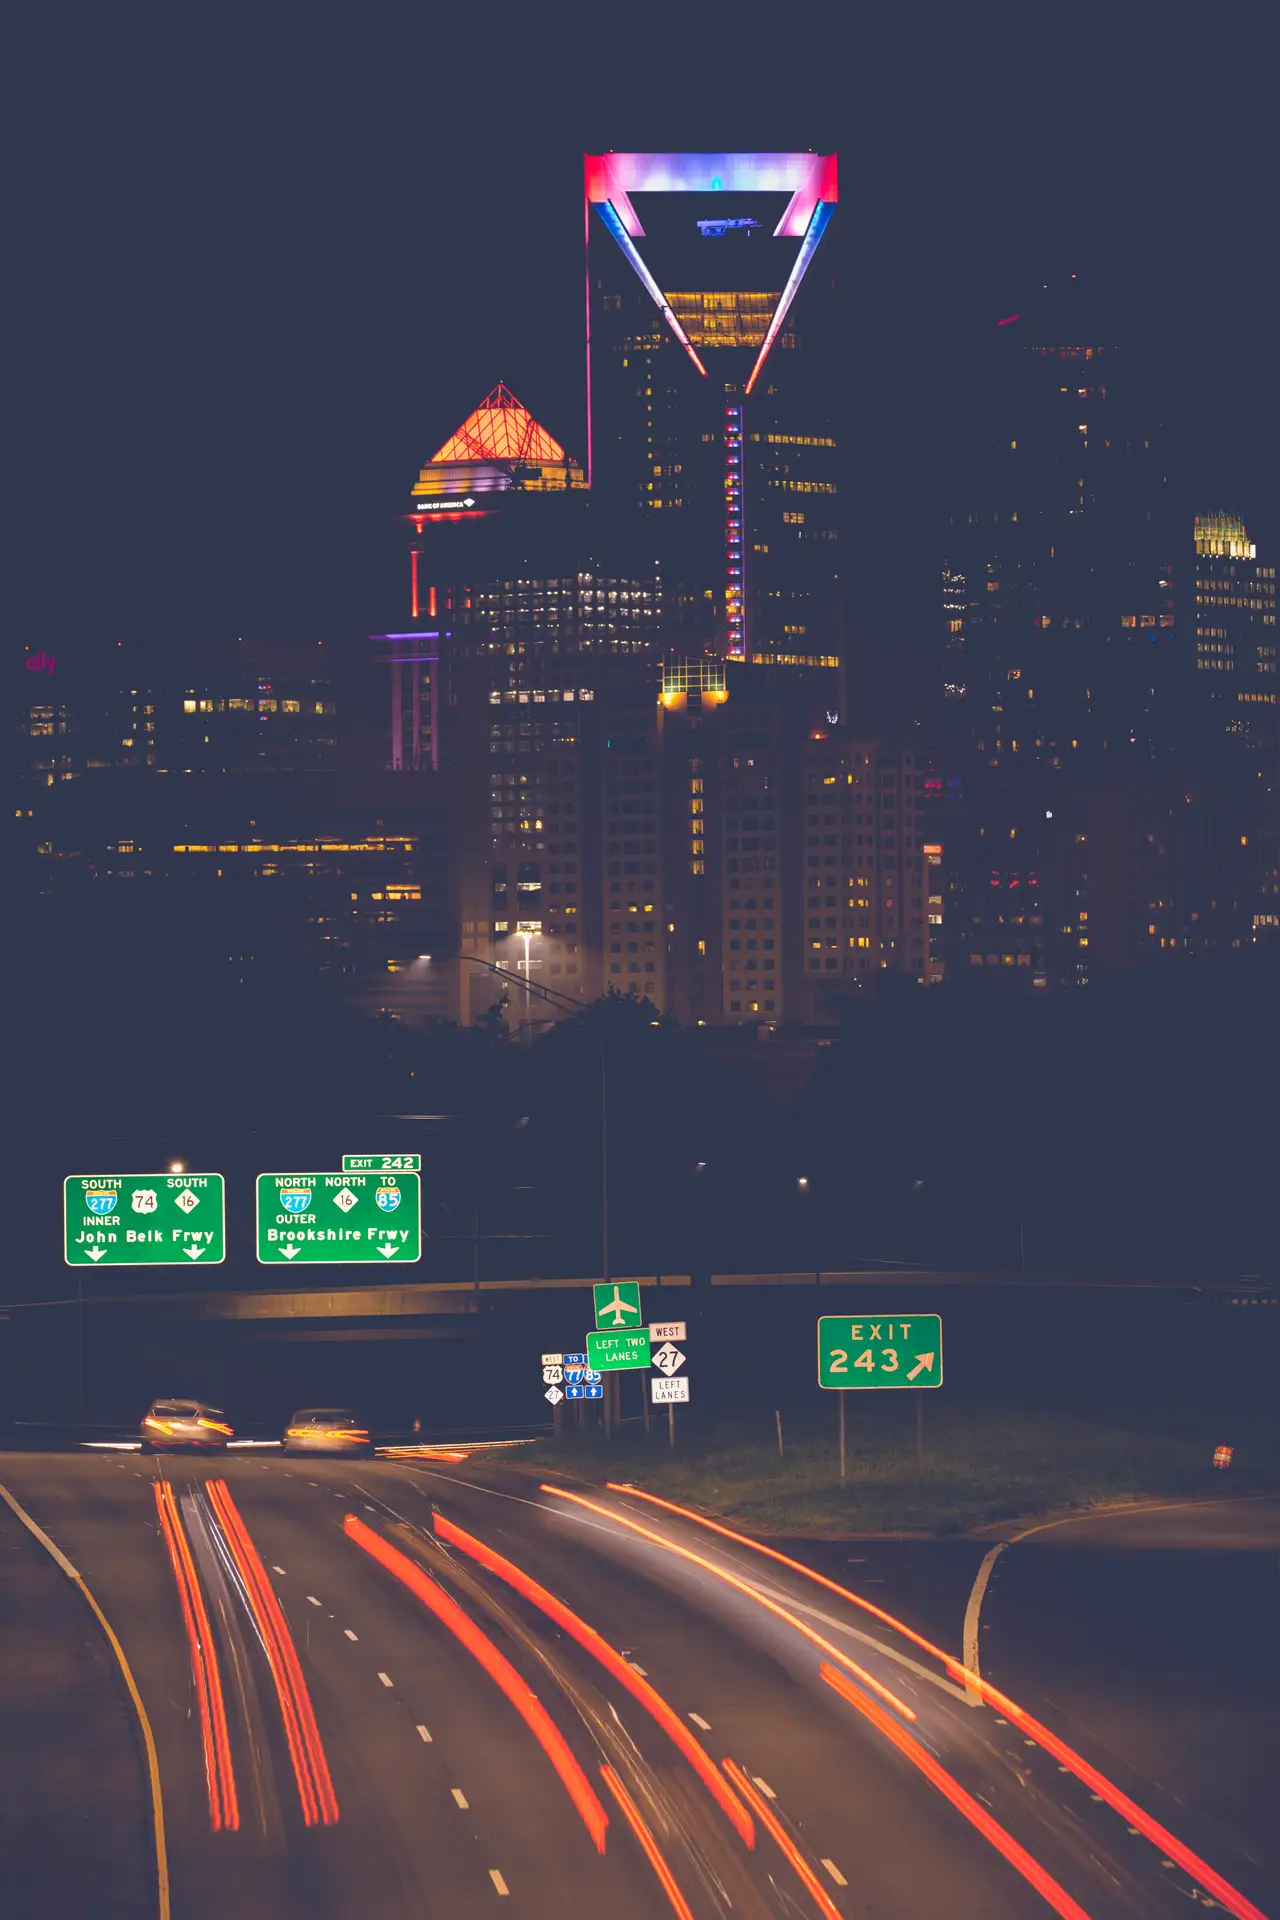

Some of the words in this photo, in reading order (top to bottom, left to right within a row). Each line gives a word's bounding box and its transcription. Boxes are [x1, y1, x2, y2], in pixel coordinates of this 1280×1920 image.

[25, 651, 57, 675] ally
[350, 1159, 373, 1168] EXIT
[381, 1157, 414, 1169] 242
[81, 1179, 122, 1189] SOUTH
[167, 1178, 208, 1188] SOUTH
[275, 1177, 316, 1187] NORTH
[325, 1177, 366, 1187] NORTH
[380, 1176, 396, 1186] TO
[90, 1198, 113, 1210] 277
[135, 1196, 154, 1208] 74
[182, 1195, 195, 1207] 16
[285, 1196, 308, 1208] 277
[340, 1194, 353, 1206] 16
[378, 1193, 399, 1207] 85
[83, 1216, 121, 1226] INNER
[276, 1214, 316, 1224] OUTER
[75, 1231, 117, 1243] John
[126, 1230, 163, 1242] Belk
[172, 1229, 214, 1244] Frwy
[267, 1228, 362, 1241] Brookshire
[367, 1227, 409, 1243] Frwy
[655, 1326, 680, 1337] WEST
[851, 1323, 912, 1341] EXIT
[595, 1339, 619, 1349] LEFT
[626, 1337, 646, 1347] TWO
[605, 1351, 638, 1362] LANES
[658, 1351, 679, 1368] 27
[829, 1348, 899, 1373] 243
[545, 1369, 560, 1380] 74
[566, 1370, 582, 1381] 77
[585, 1370, 601, 1381] 85
[659, 1380, 681, 1390] LEFT
[548, 1390, 559, 1400] 27
[655, 1390, 686, 1400] LANES
